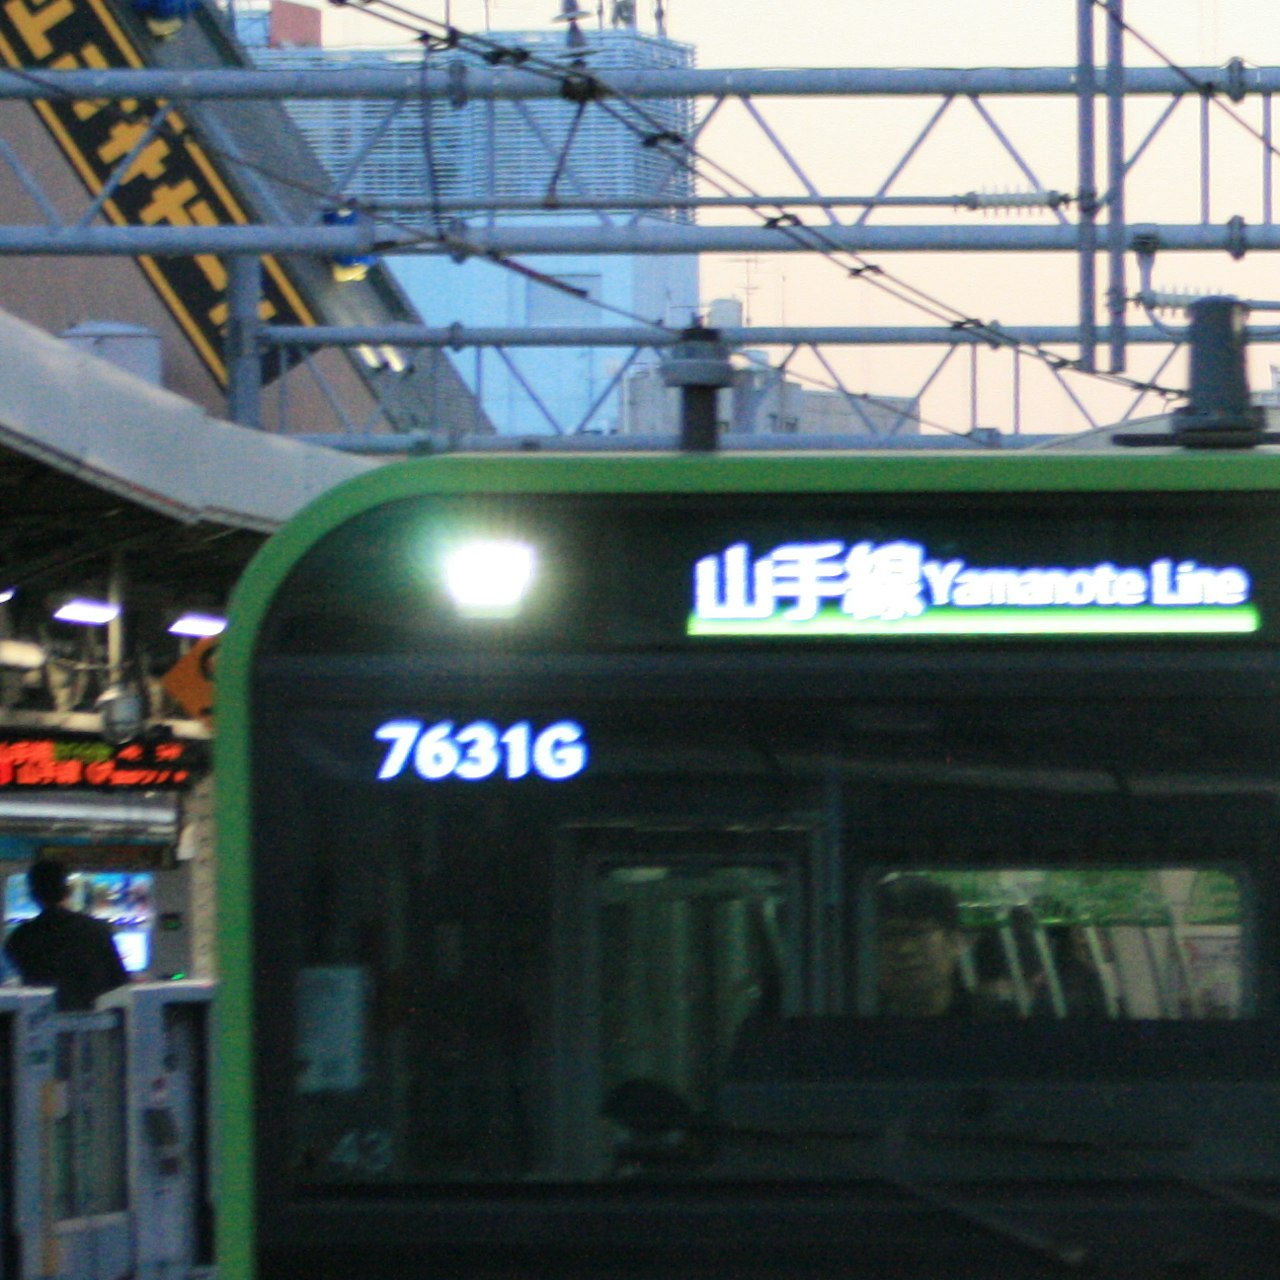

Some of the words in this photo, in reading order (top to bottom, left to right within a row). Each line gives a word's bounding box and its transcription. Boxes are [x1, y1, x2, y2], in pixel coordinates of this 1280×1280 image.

[693, 540, 926, 620] 山手線
[925, 558, 1148, 607] Yamanote
[1150, 558, 1249, 606] Line
[374, 720, 586, 781] 7631G
